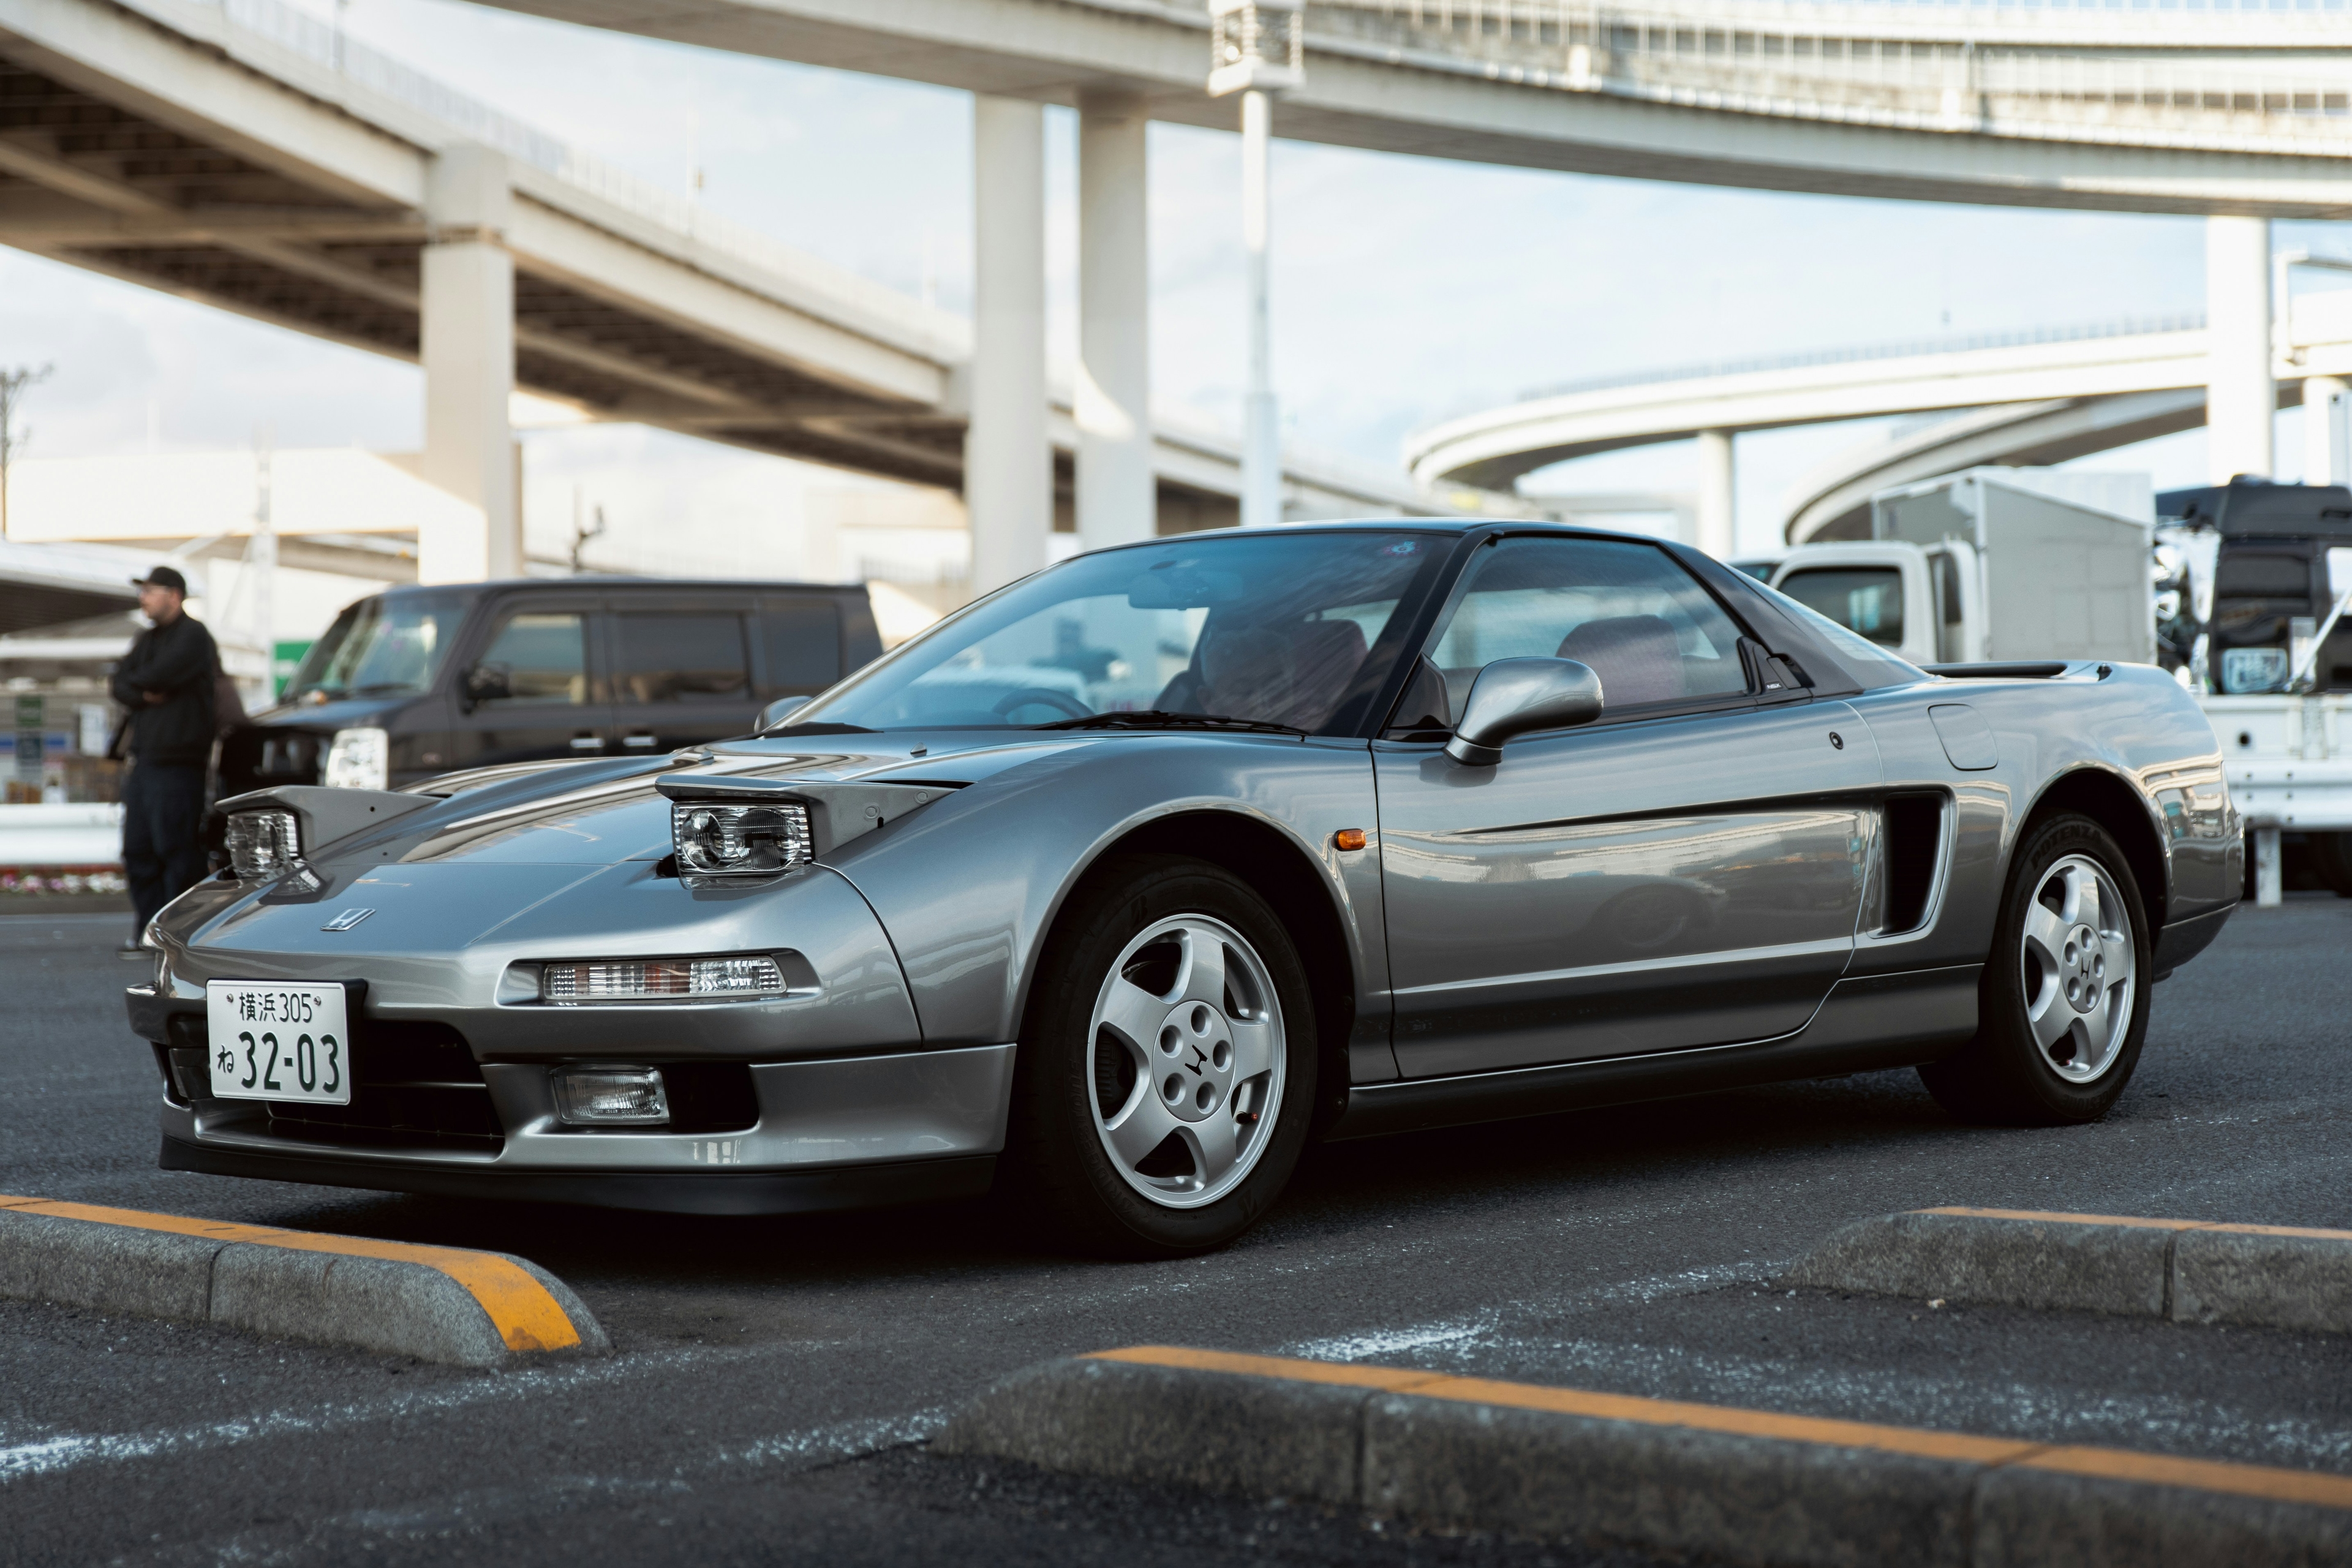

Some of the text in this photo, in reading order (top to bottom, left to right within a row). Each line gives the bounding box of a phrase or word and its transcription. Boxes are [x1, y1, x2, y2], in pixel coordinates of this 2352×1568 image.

[239, 992, 312, 1023] 横浜 305
[217, 1031, 339, 1093] ね 32-03
